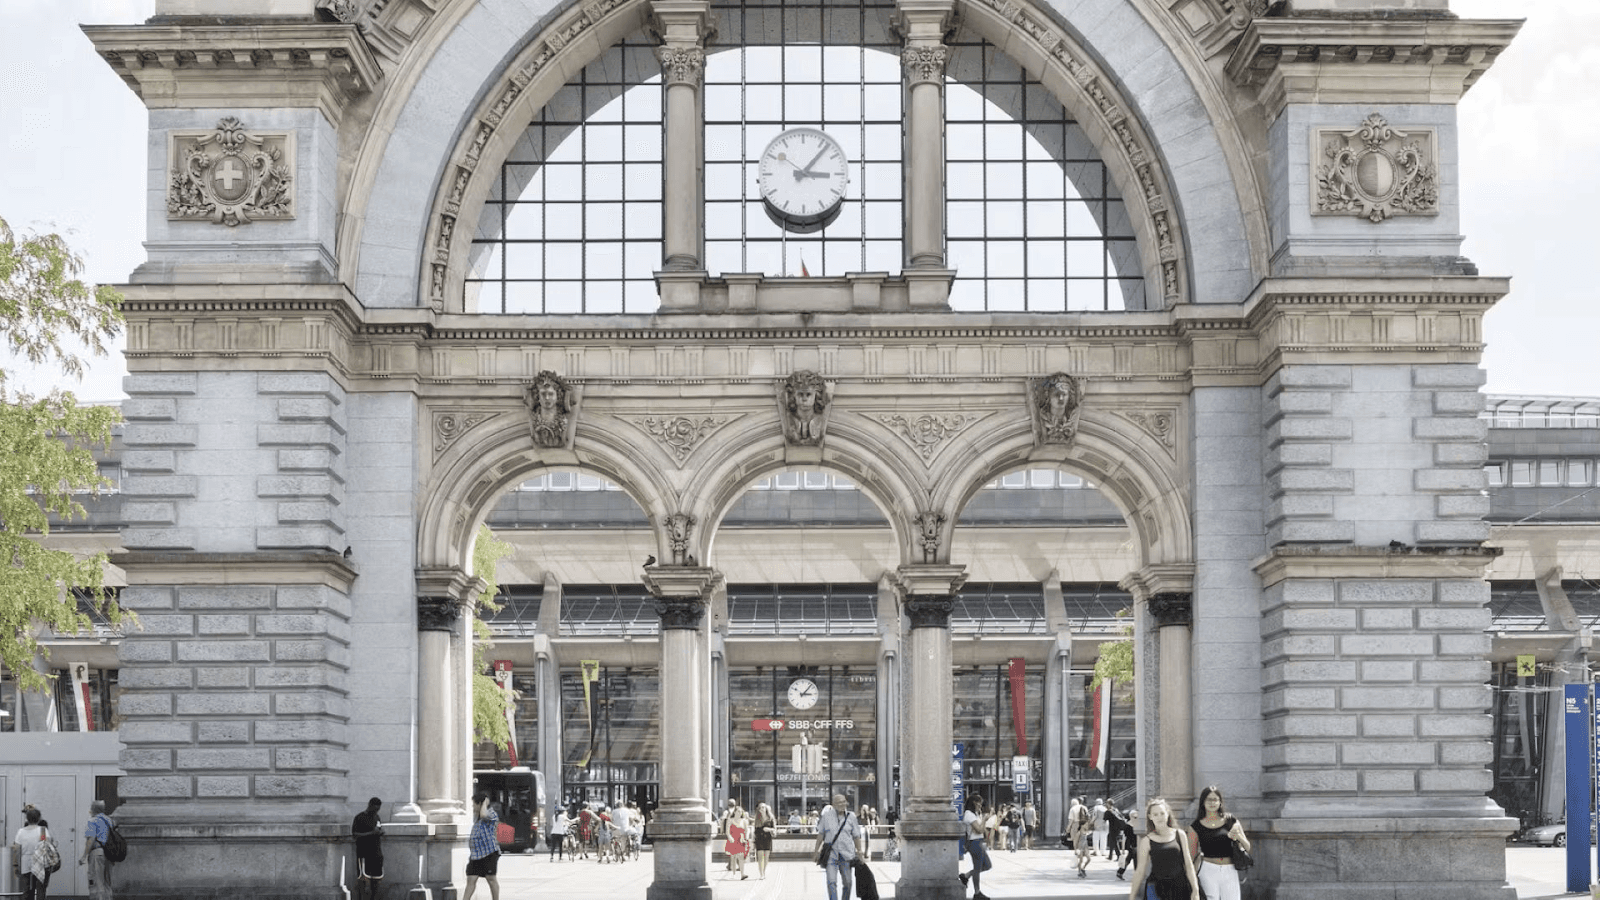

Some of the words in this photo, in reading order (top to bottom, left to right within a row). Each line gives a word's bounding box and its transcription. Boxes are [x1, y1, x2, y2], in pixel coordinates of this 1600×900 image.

[788, 720, 810, 729] SBB
[814, 720, 832, 729] CFF
[835, 720, 853, 729] FFS
